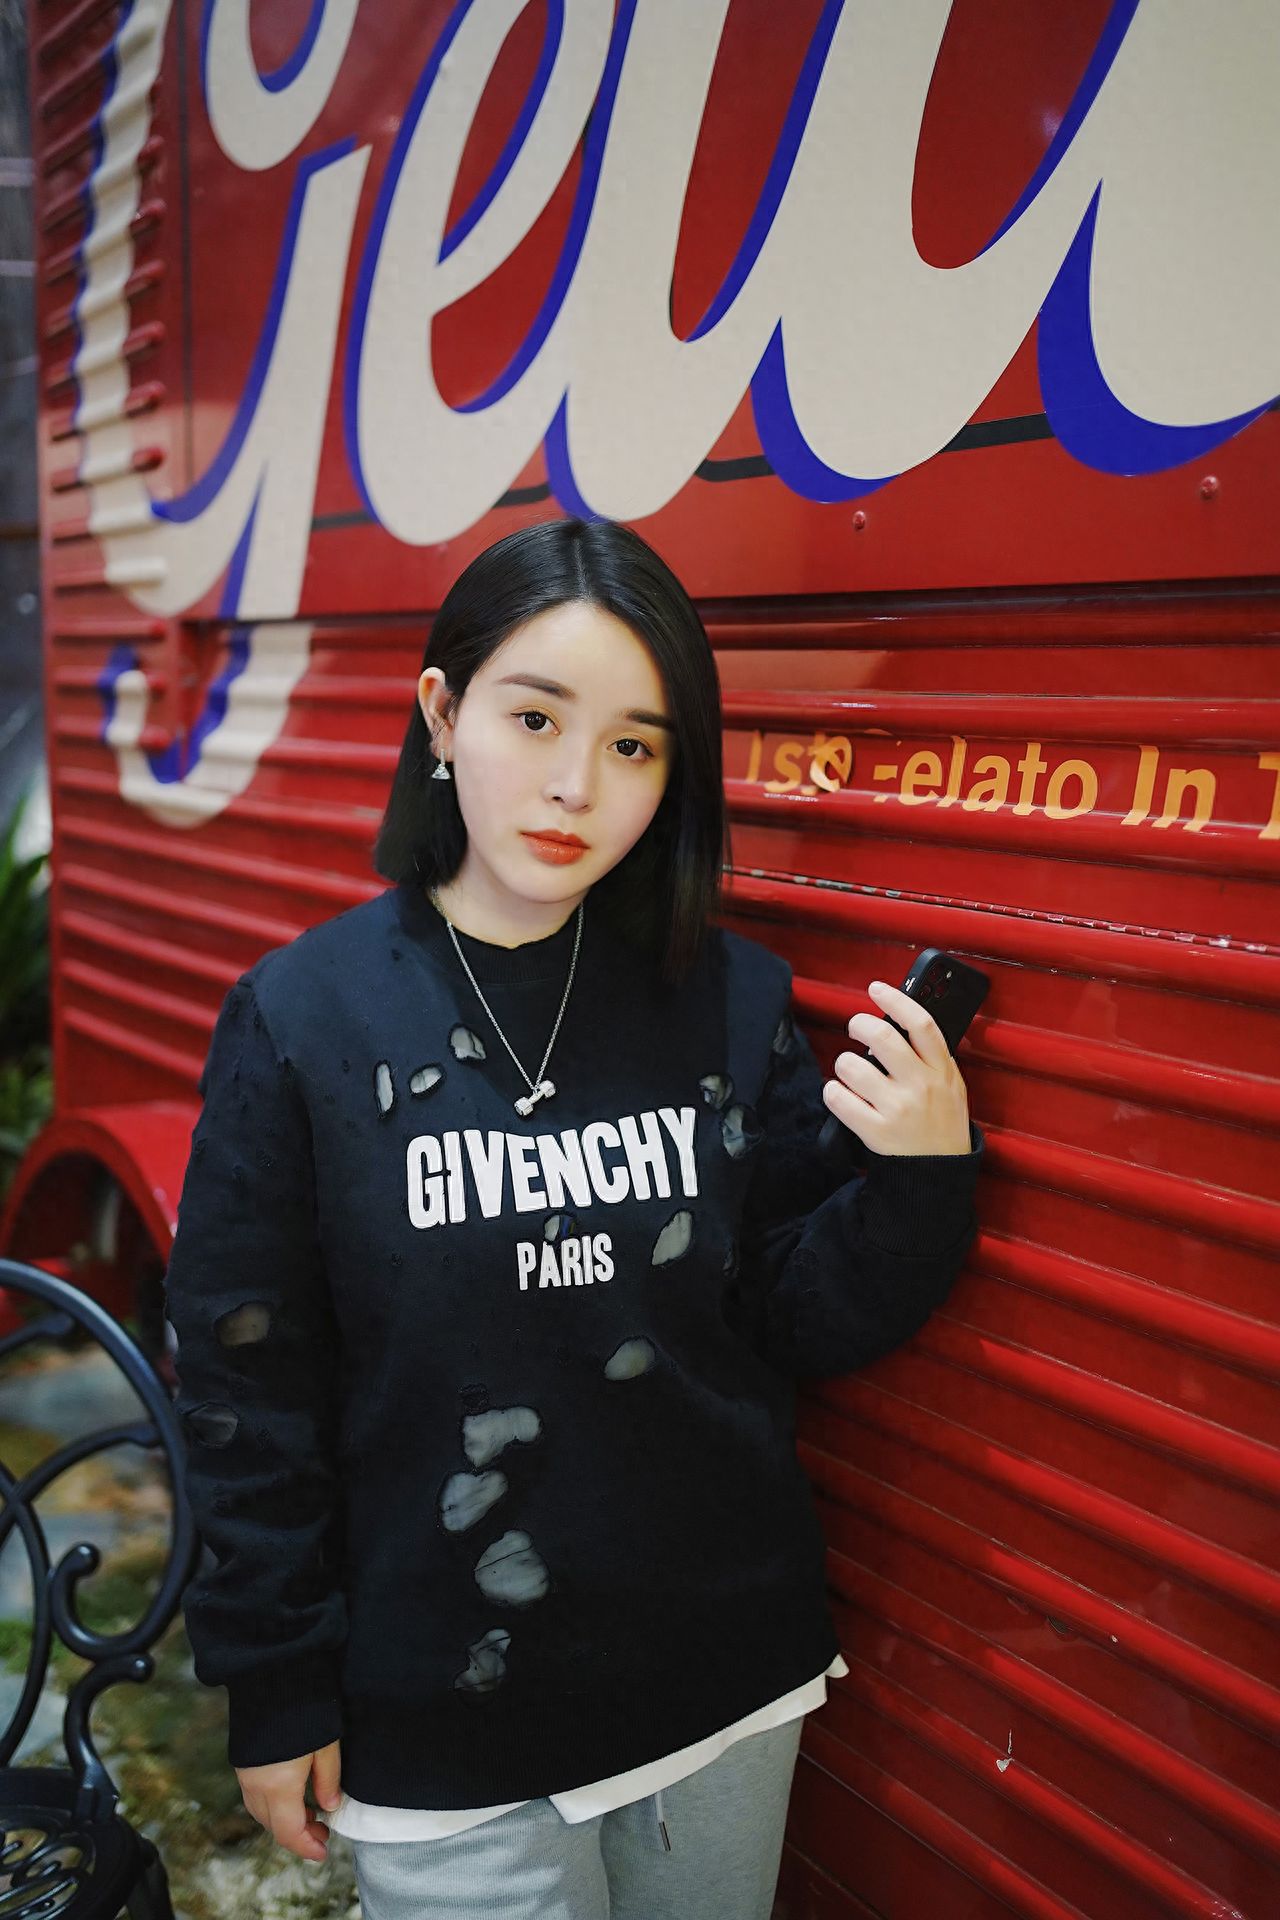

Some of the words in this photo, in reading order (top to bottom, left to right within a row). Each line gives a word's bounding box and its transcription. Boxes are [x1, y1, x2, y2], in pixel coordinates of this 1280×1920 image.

[1120, 744, 1217, 832] In
[406, 1107, 699, 1229] GIVENCHY
[516, 1233, 615, 1291] PARIS
